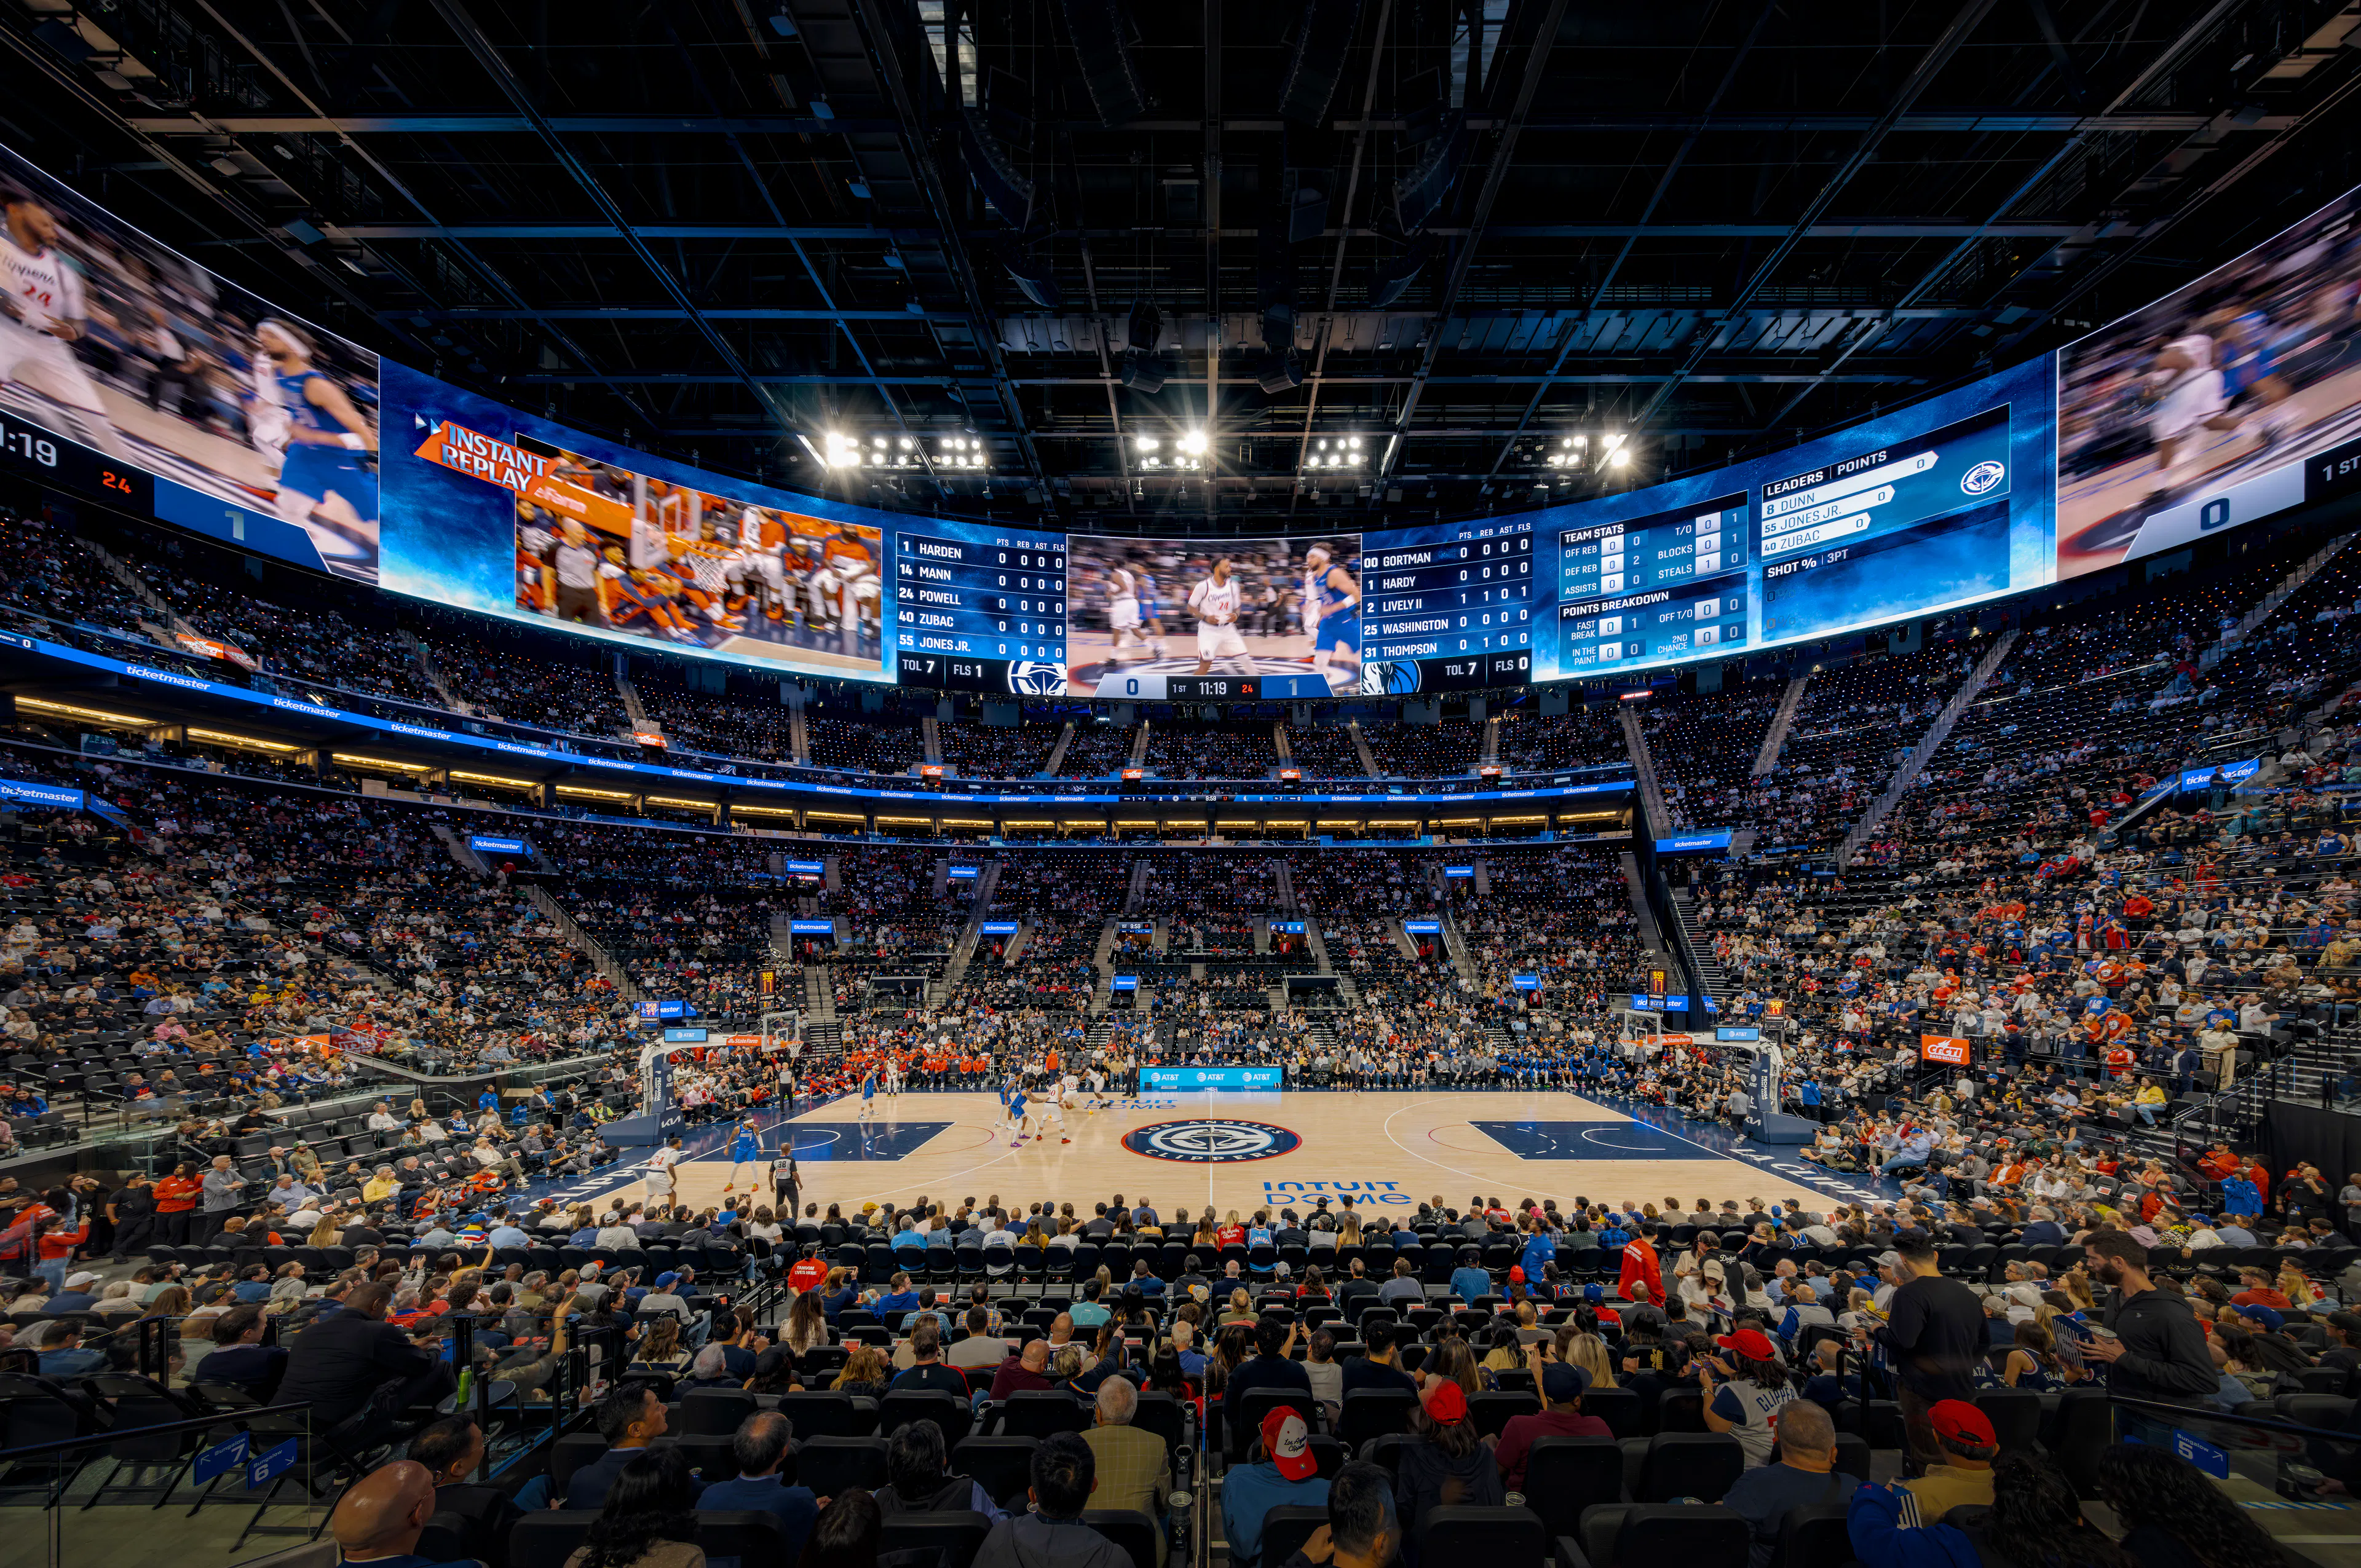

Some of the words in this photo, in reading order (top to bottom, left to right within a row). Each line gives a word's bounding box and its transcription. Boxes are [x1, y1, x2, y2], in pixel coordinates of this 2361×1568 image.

[449, 424, 547, 476] INSTANT
[441, 443, 532, 492] REPLAY
[1767, 471, 1824, 496] LEADERS
[1838, 451, 1887, 475] POINTS
[2322, 465, 2332, 481] 1
[2339, 457, 2361, 474] ST
[103, 471, 131, 494] 24
[1767, 504, 1774, 514] 8
[1781, 493, 1814, 511] DUNN
[1765, 524, 1776, 533] 55
[1781, 510, 1819, 530] JONES
[1823, 505, 1841, 518] JR.
[2201, 498, 2229, 530] 0
[225, 510, 245, 541] 1
[1675, 525, 1691, 535] T/O
[1565, 529, 1592, 543] TEAM
[1594, 524, 1624, 537] STATS
[1765, 543, 1776, 551] 40
[1781, 530, 1819, 549] ZUBAC
[903, 541, 909, 552] 1
[919, 543, 962, 559] HARDEN
[997, 538, 1009, 547] PTS
[1035, 542, 1048, 550] AST
[1565, 548, 1580, 557] OFF
[1583, 545, 1597, 554] REB
[1658, 545, 1692, 559] BLOCKS
[1364, 557, 1378, 568] 00
[1383, 552, 1431, 566] GORTMAN
[1768, 561, 1798, 577] SHOT
[1801, 558, 1816, 568] %
[1827, 549, 1848, 564] 3PT
[900, 564, 912, 575] 14
[919, 567, 951, 581] MANN
[1565, 567, 1580, 576] DEF
[1583, 564, 1597, 573] REB
[1658, 565, 1692, 578] STEALS
[1368, 580, 1374, 590] 1
[1383, 576, 1416, 589] HARDY
[1565, 583, 1596, 594] ASSISTS
[899, 588, 914, 599] 24
[919, 591, 961, 605] POWELL
[1564, 603, 1599, 617] POINTS
[1602, 591, 1669, 610] BREAKDOWN
[1367, 602, 1374, 613] 2
[1383, 600, 1414, 612] LIVELY
[1416, 599, 1422, 609] II
[899, 611, 914, 623] 40
[919, 613, 954, 627] ZUBAC
[1659, 612, 1675, 623] OFF
[1677, 609, 1693, 620] T/O
[1364, 625, 1377, 636] 25
[1383, 619, 1448, 634] WASHINGTON
[1577, 621, 1596, 631] FAST
[1571, 630, 1596, 640] BREAK
[1672, 634, 1687, 643] 2ND
[900, 634, 914, 646] 55
[919, 637, 953, 650] JONES
[955, 640, 971, 652] JR.
[1365, 647, 1377, 658] 31
[1383, 643, 1437, 656] THOMPSON
[1581, 646, 1596, 655] THE
[1658, 643, 1687, 653] CHANCE
[903, 660, 922, 671] TOL
[927, 661, 935, 673] 7
[1496, 660, 1514, 671] FLS
[1519, 657, 1527, 670] 0
[1574, 656, 1596, 665] PAINT
[954, 664, 971, 676] FLS
[976, 666, 981, 677] 1
[1445, 664, 1464, 676] TOL
[1468, 663, 1476, 675] 7
[127, 666, 210, 691] ticketmaster
[1126, 679, 1138, 695] 0
[1173, 684, 1177, 693] 1
[1199, 681, 1226, 695] 11:19
[1242, 684, 1253, 693] 24
[1288, 679, 1297, 695] 1
[274, 698, 340, 719] ticketmaster
[391, 722, 451, 740] ticketmaster
[497, 742, 548, 758] ticketmaster
[672, 770, 714, 781] ticketmaster
[816, 786, 852, 795] ticketmaster
[475, 840, 520, 850] ticketmaster
[764, 980, 772, 993] 17
[1655, 980, 1663, 992] 17
[1139, 1124, 1172, 1135] LOS
[1189, 1120, 1284, 1134] ANGELES
[652, 1156, 663, 1166] 24
[1145, 1148, 1279, 1162] CLIPPERS
[1729, 1149, 1775, 1162] LA
[215, 1437, 246, 1456] Bungalow
[2177, 1433, 2209, 1452] Bungalow
[2178, 1440, 2193, 1459] 5
[231, 1443, 245, 1462] 7
[253, 1450, 282, 1468] Bungalow
[255, 1464, 269, 1481] 6
